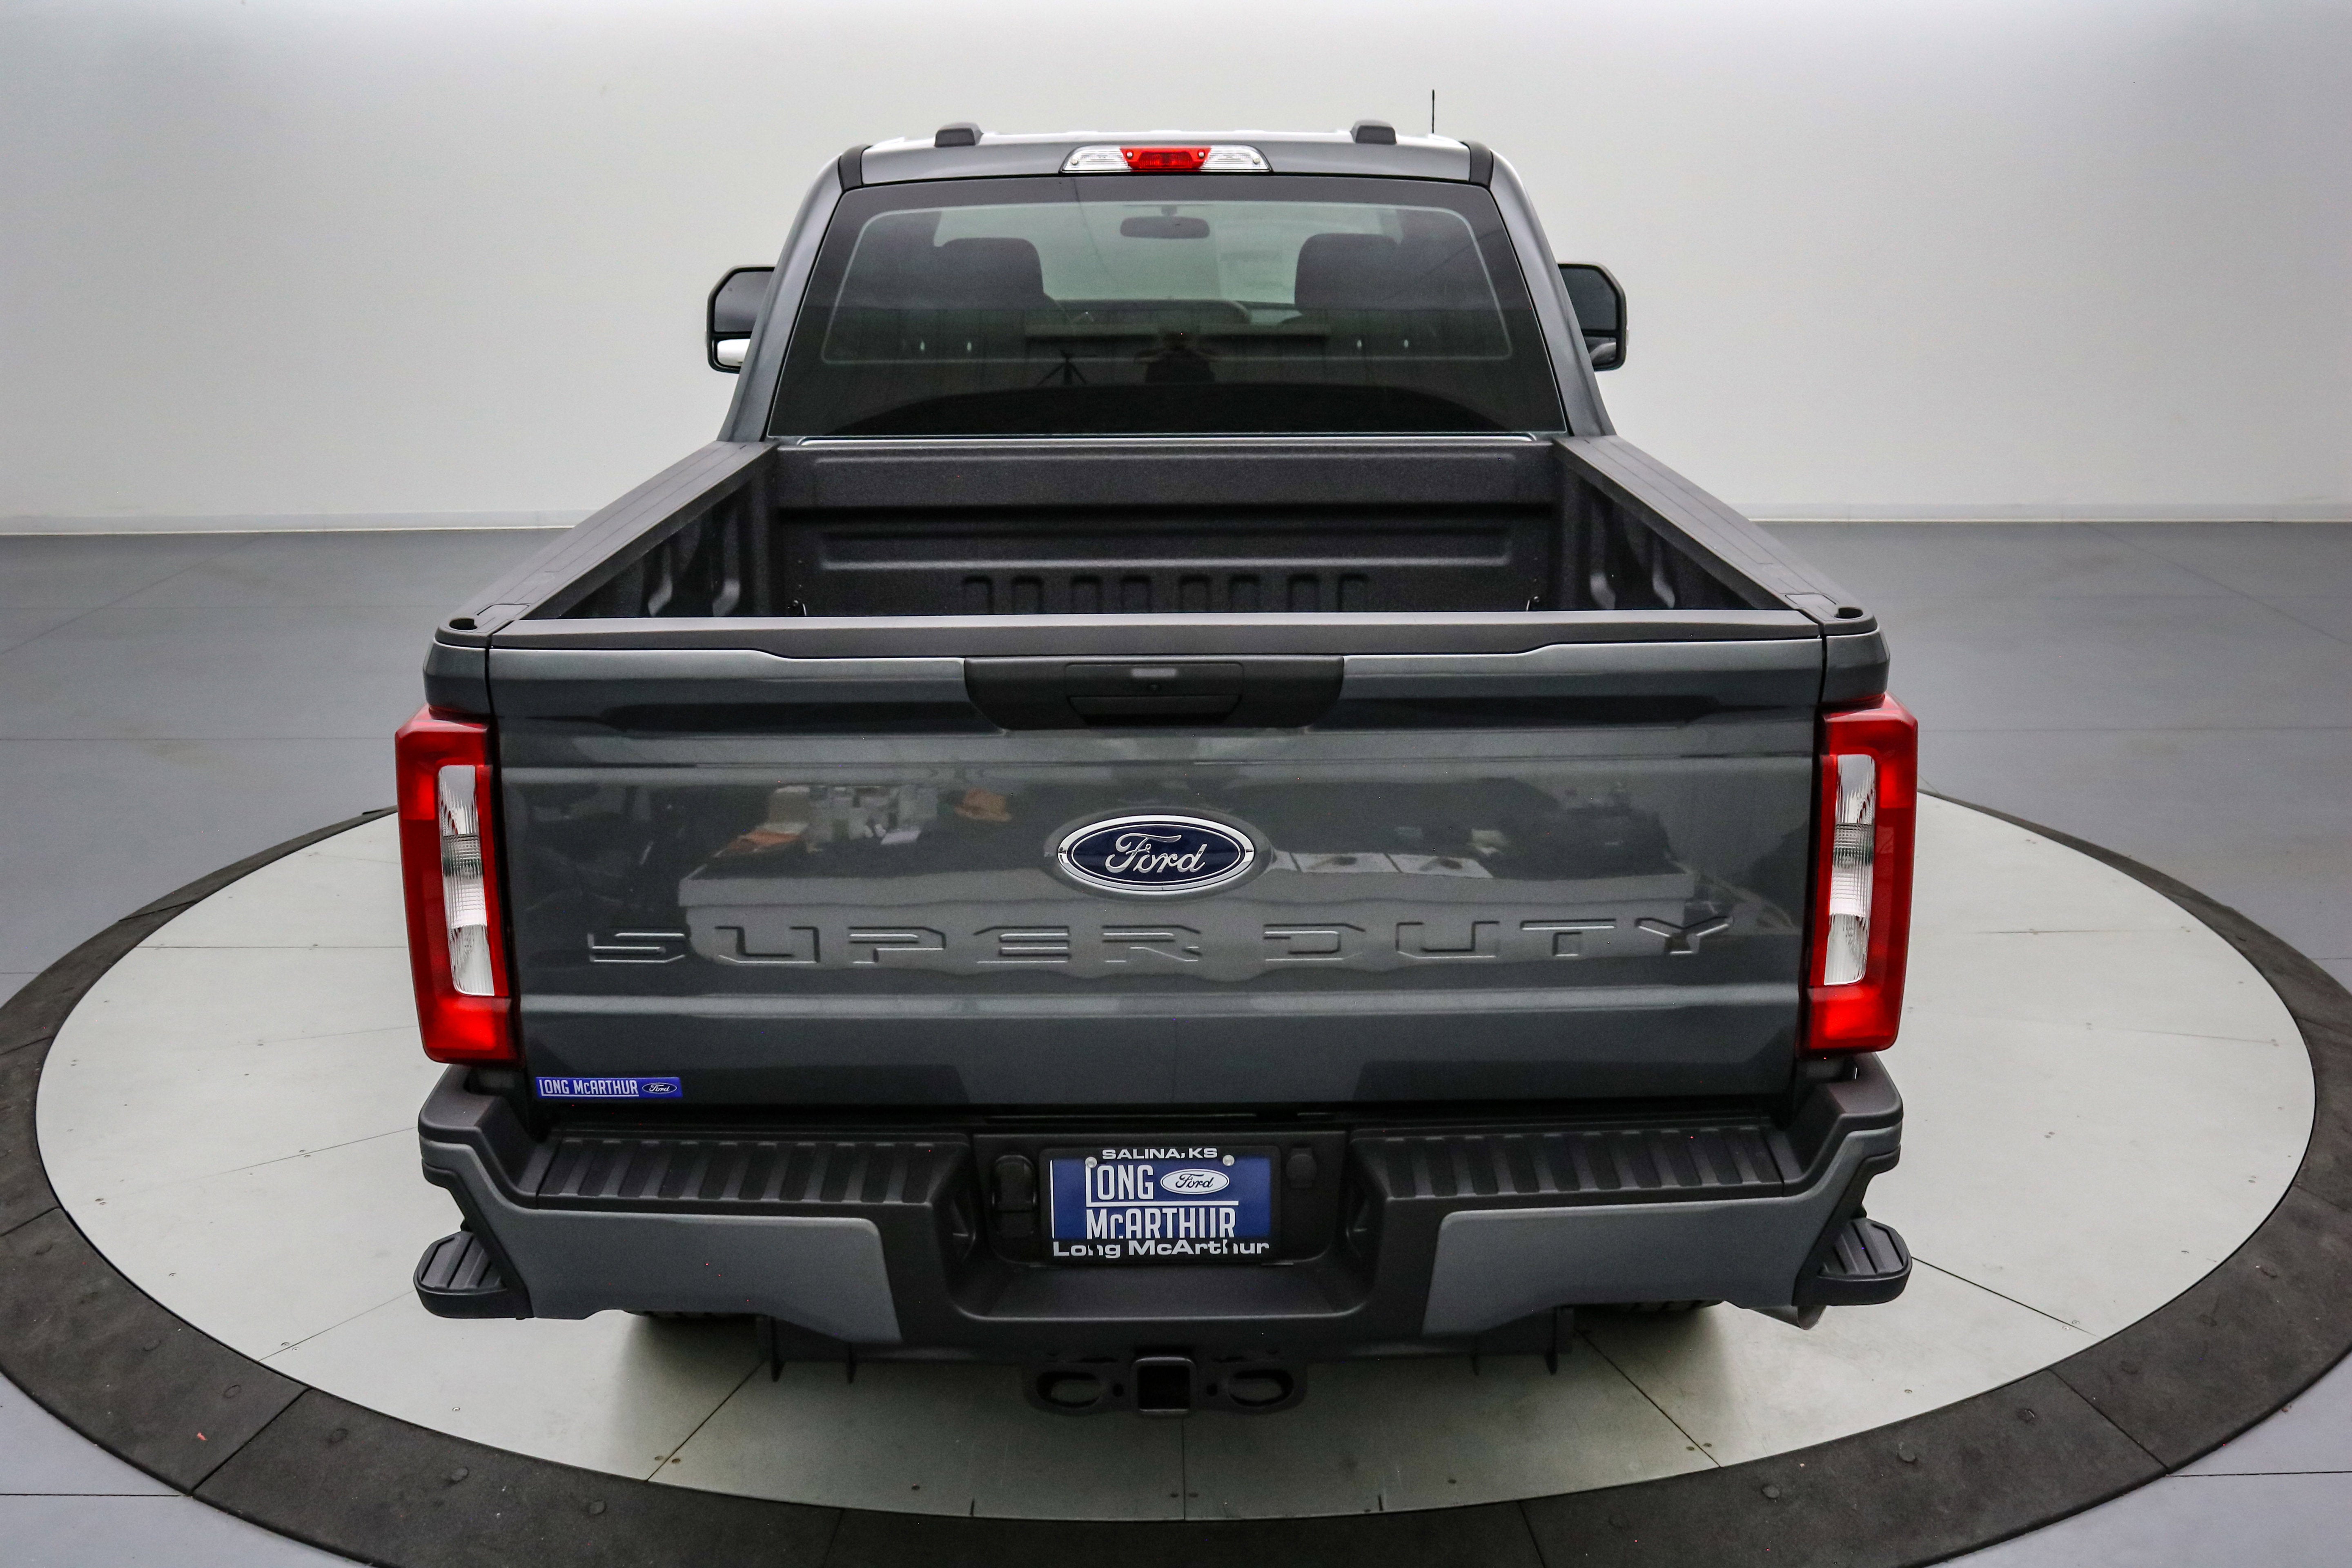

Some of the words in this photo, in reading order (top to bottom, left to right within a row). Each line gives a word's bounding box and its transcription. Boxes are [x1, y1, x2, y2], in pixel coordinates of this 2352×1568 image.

[1105, 833, 1207, 873] Ford
[588, 924, 1203, 964] SUPER
[1263, 915, 1734, 961] DUTY
[539, 1079, 570, 1096] LONG
[573, 1080, 639, 1094] McARTHUR
[648, 1084, 670, 1092] Ford
[1188, 1147, 1218, 1159] KS
[1085, 1164, 1154, 1207] LONG
[1175, 1173, 1214, 1189] Ford
[1086, 1207, 1236, 1239] McARTHUR
[1053, 1241, 1121, 1258] Long
